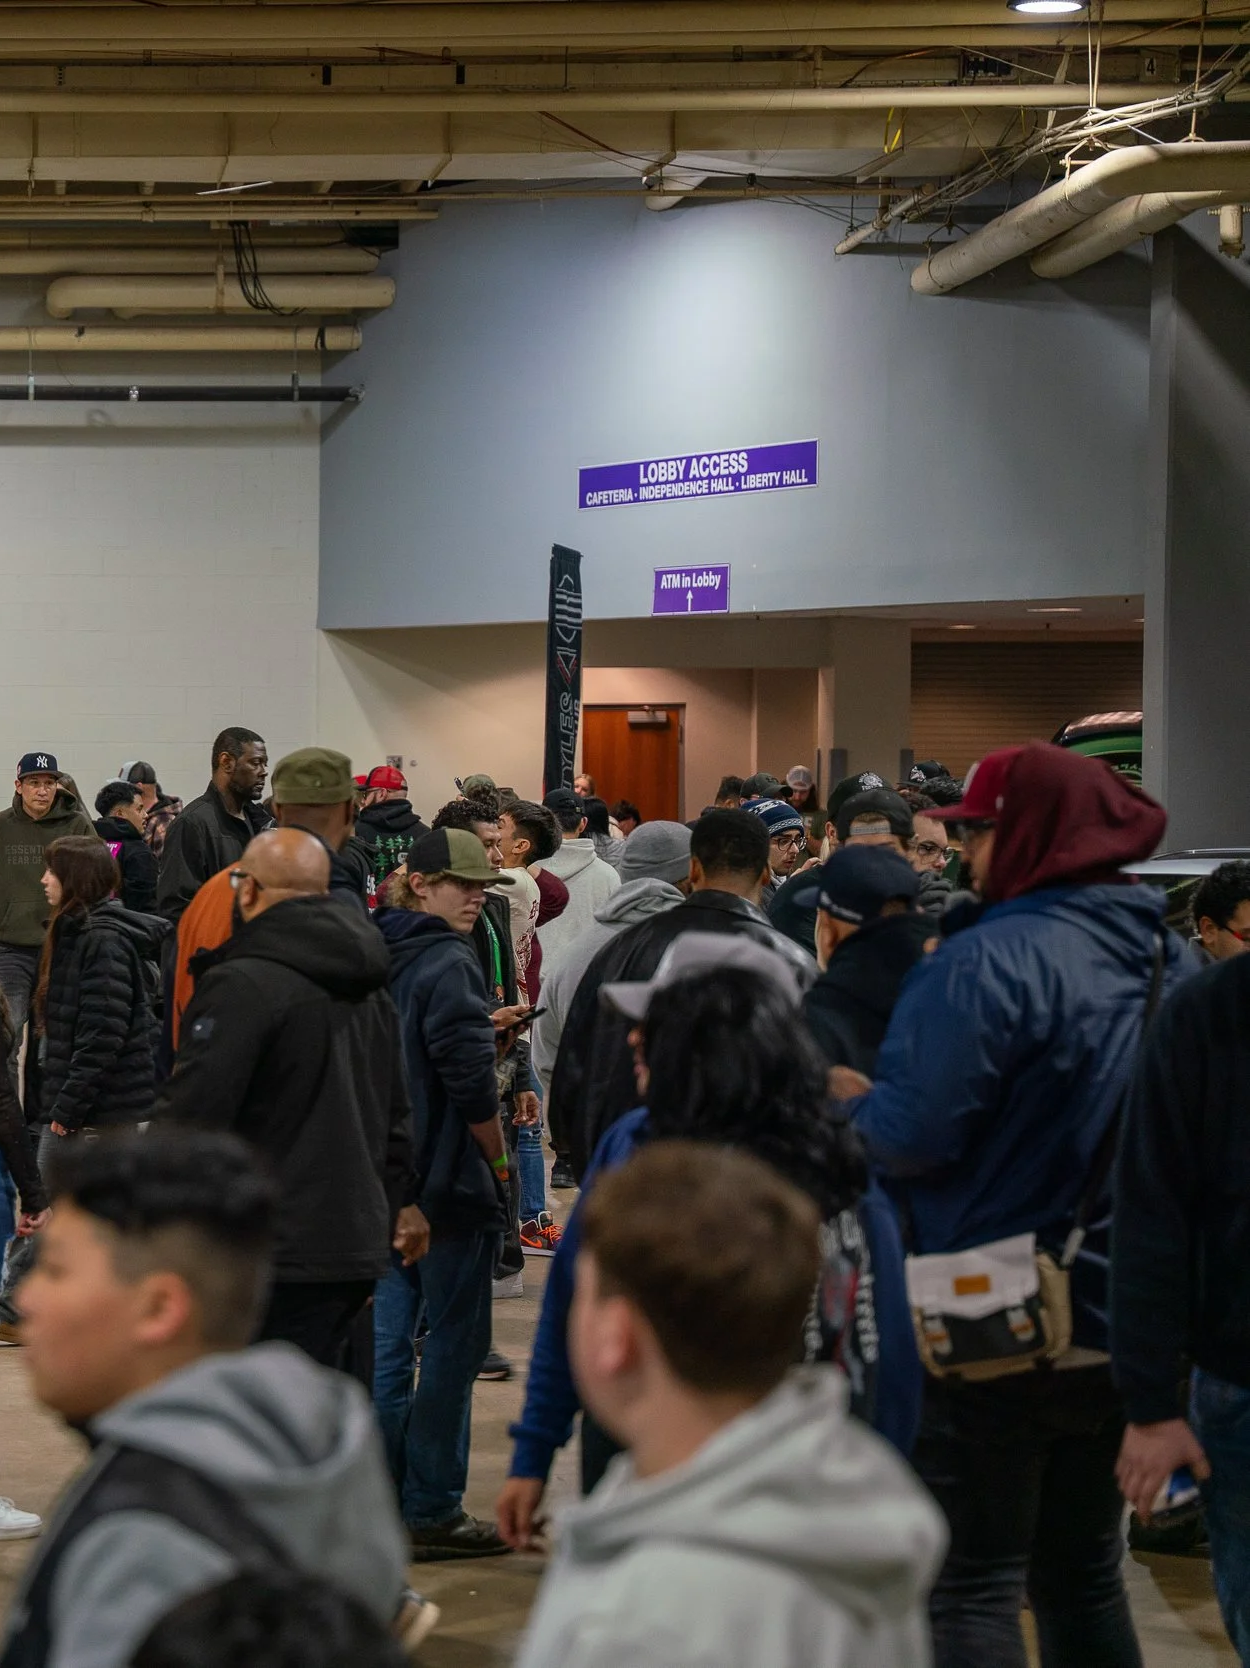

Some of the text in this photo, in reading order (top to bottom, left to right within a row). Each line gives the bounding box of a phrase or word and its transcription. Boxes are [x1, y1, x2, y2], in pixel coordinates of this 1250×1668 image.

[1146, 57, 1155, 75] 4
[639, 452, 748, 484] LOBBY ACCESS
[586, 469, 808, 506] CAFETERIA INDEPENDENCE HALL LIBERTY HALL
[660, 570, 721, 590] ATM in Lobby
[5, 844, 45, 855] ESSENTI
[7, 855, 43, 865] FEAR OF
